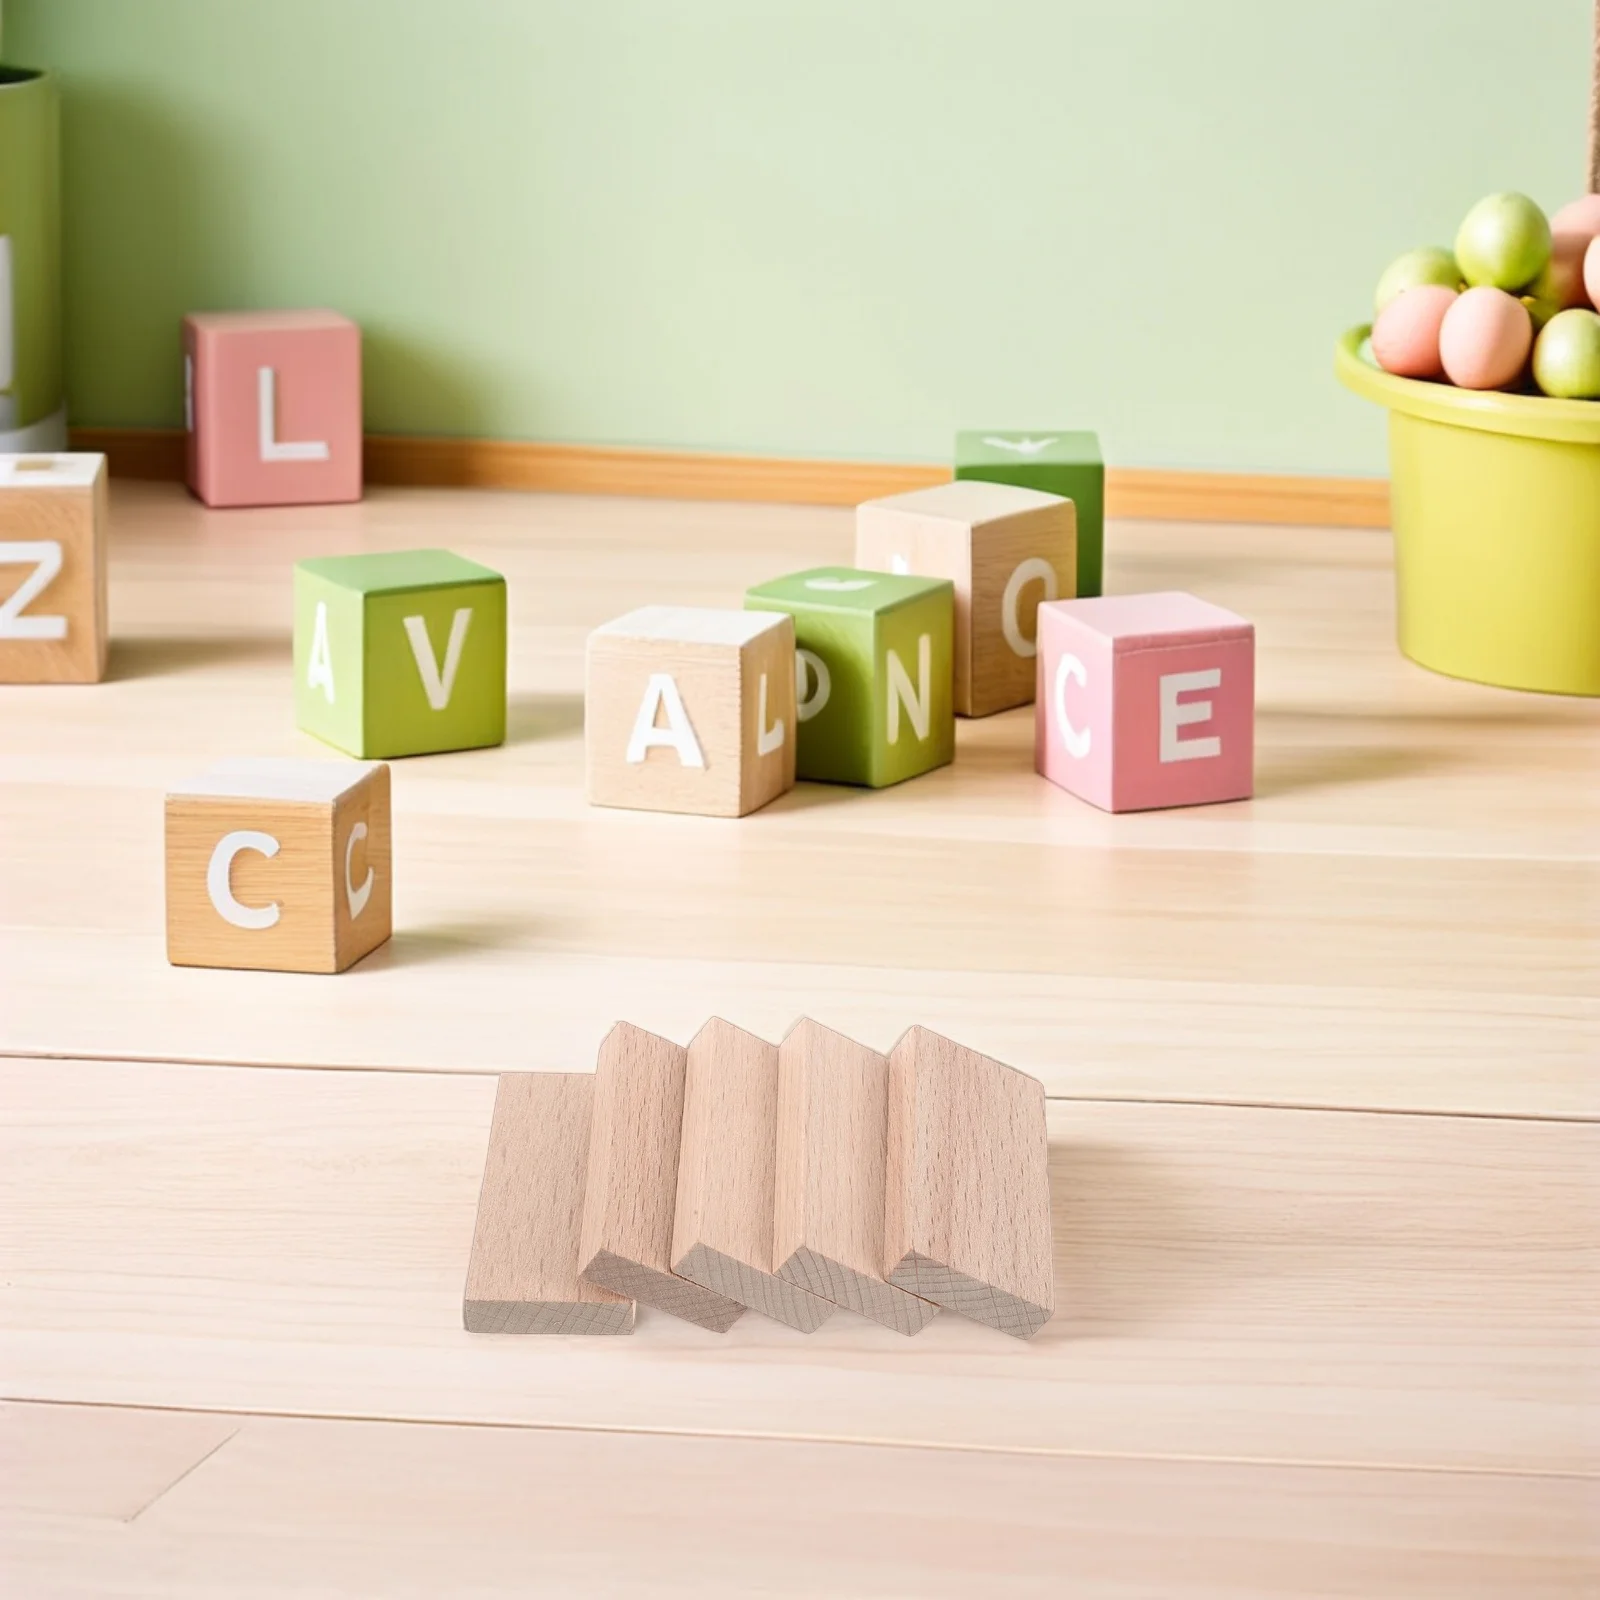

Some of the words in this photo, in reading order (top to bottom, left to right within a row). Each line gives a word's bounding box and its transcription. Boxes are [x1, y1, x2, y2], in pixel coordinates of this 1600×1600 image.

[258, 366, 329, 462] L
[0, 540, 68, 639] Z
[307, 601, 335, 704] A
[403, 608, 473, 710] V
[886, 633, 931, 745] N
[626, 673, 706, 769] A
[757, 673, 785, 757] L
[1054, 653, 1091, 758] C
[1158, 668, 1221, 763] E
[207, 830, 280, 929] C
